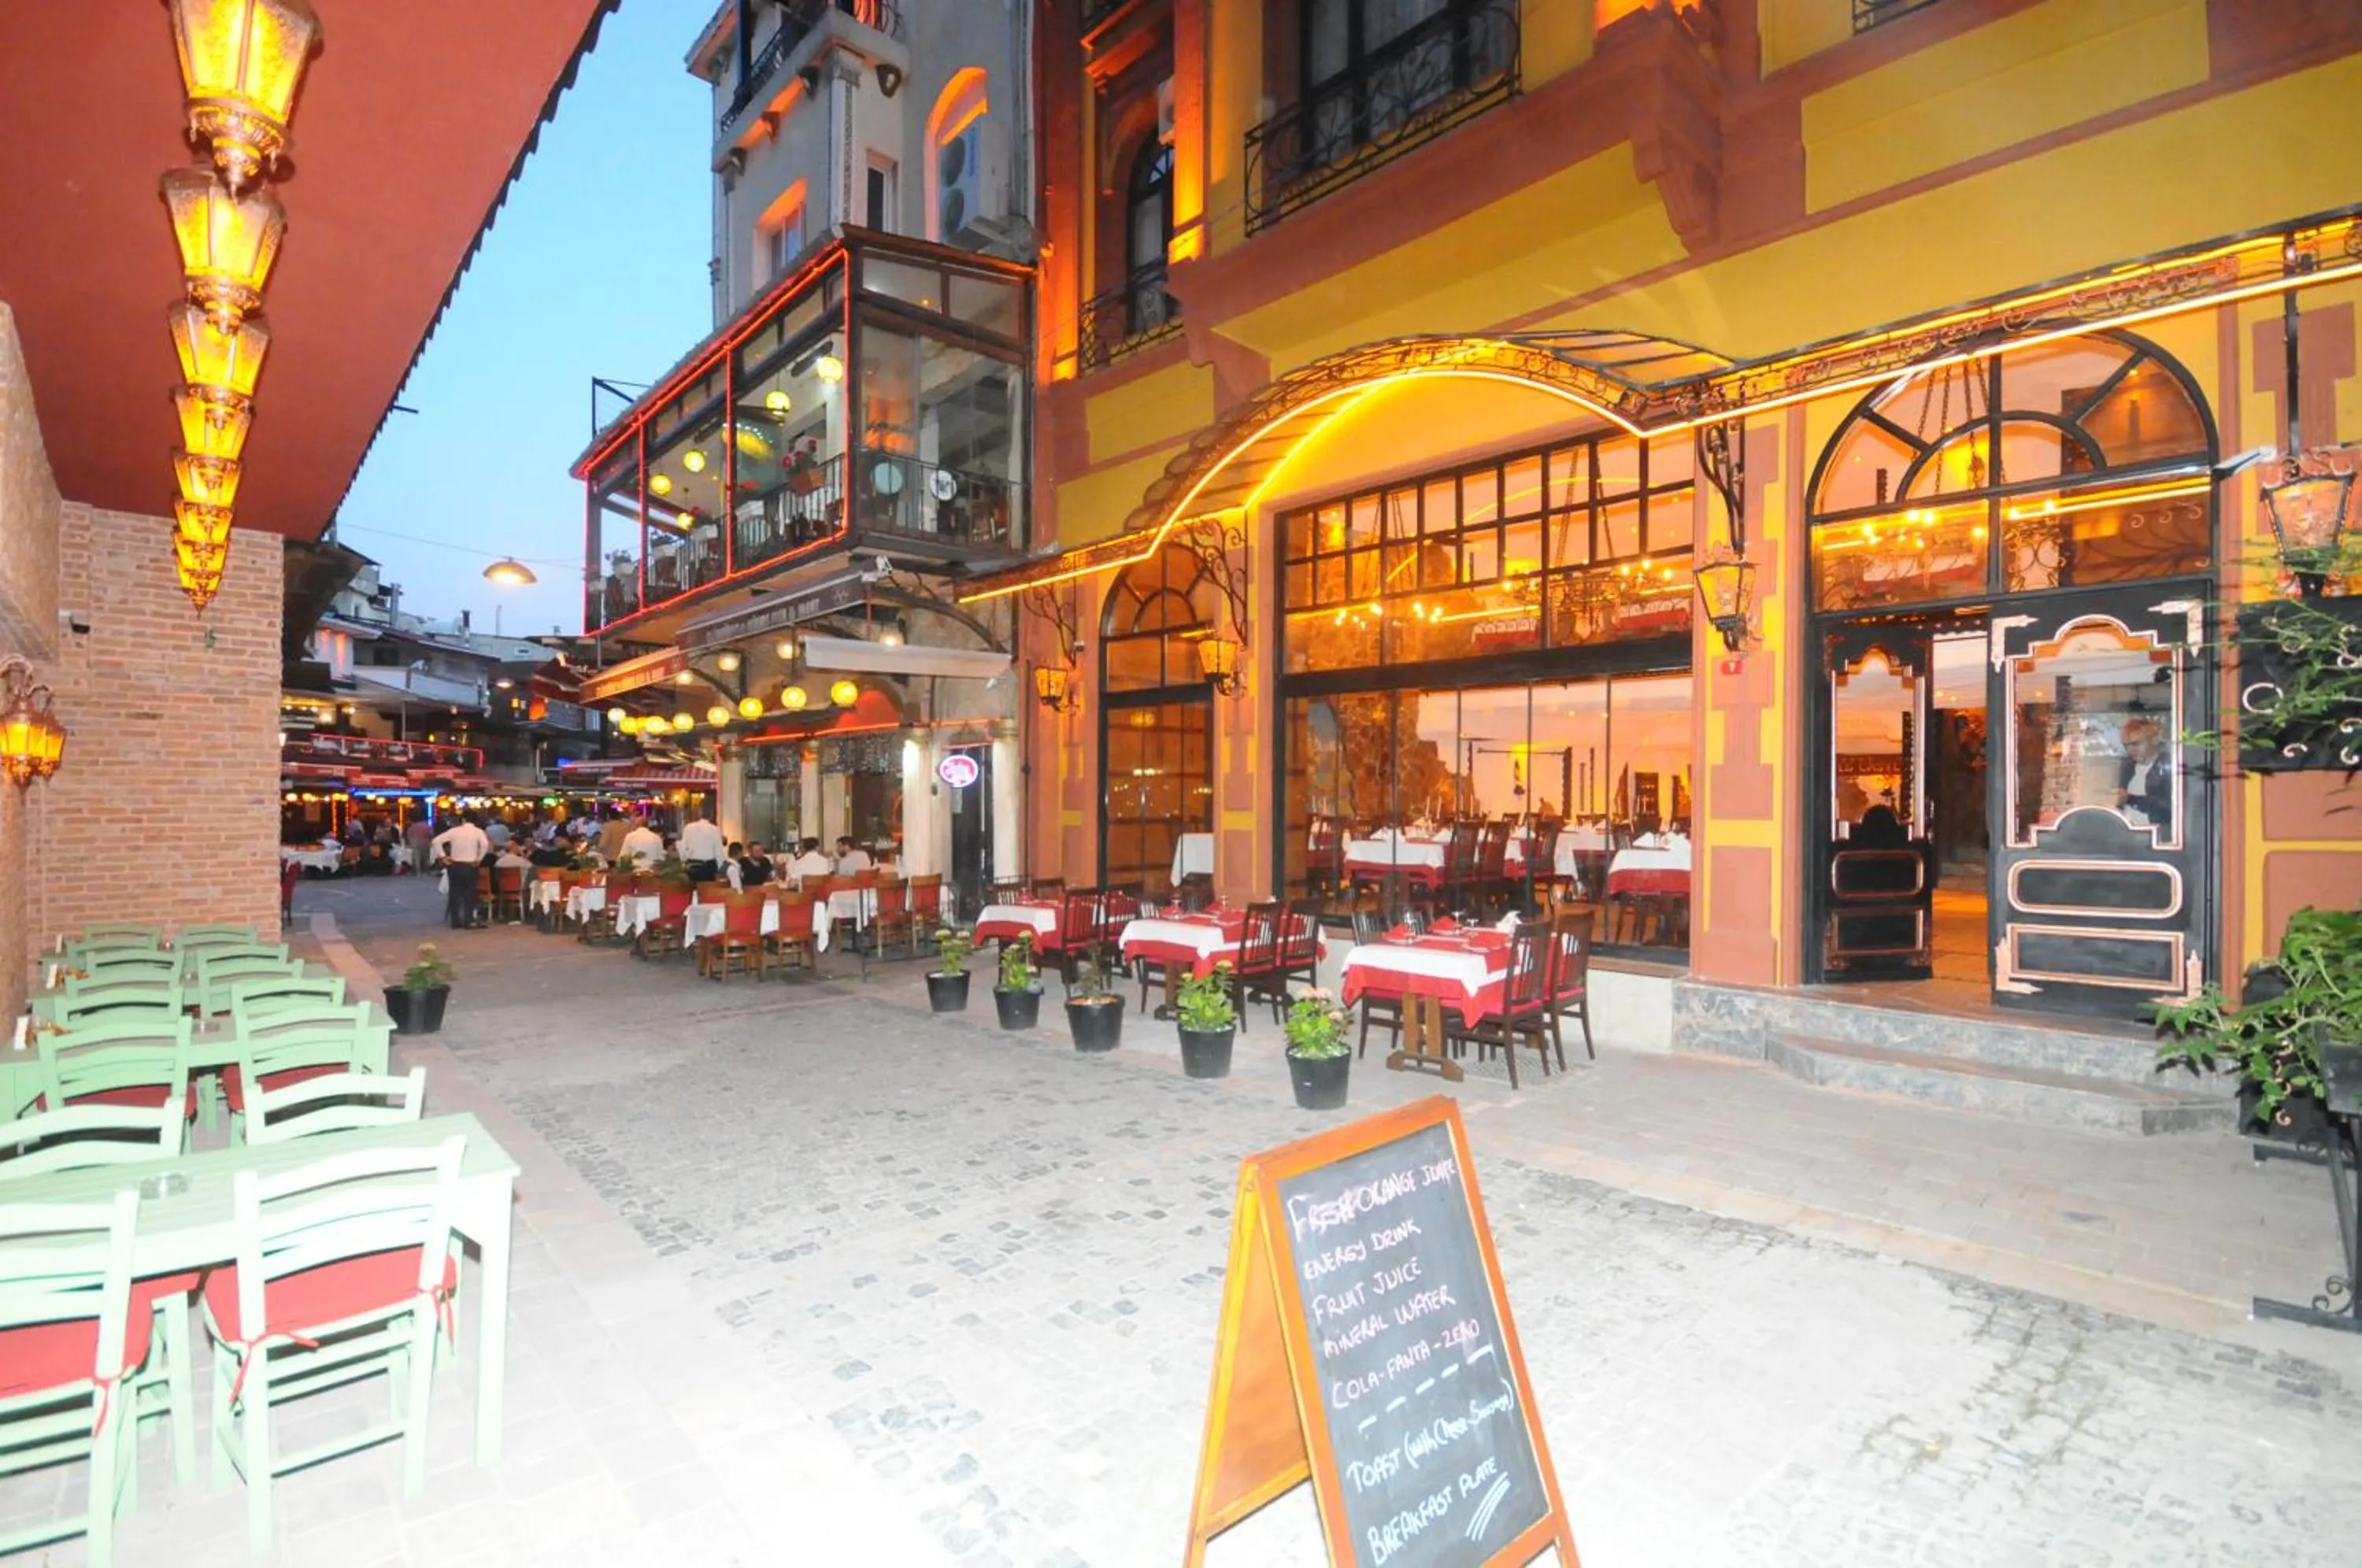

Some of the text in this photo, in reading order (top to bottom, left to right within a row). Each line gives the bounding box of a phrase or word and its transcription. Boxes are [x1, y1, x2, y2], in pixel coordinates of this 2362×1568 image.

[1304, 1218, 1422, 1281] ENERGY DRINK
[1312, 1256, 1422, 1325] FRUIT JUICE
[1323, 1285, 1457, 1359] MINERAL WATER
[1346, 1448, 1401, 1494] TOAST
[1367, 1457, 1498, 1566] BREAKFAST PLATE
